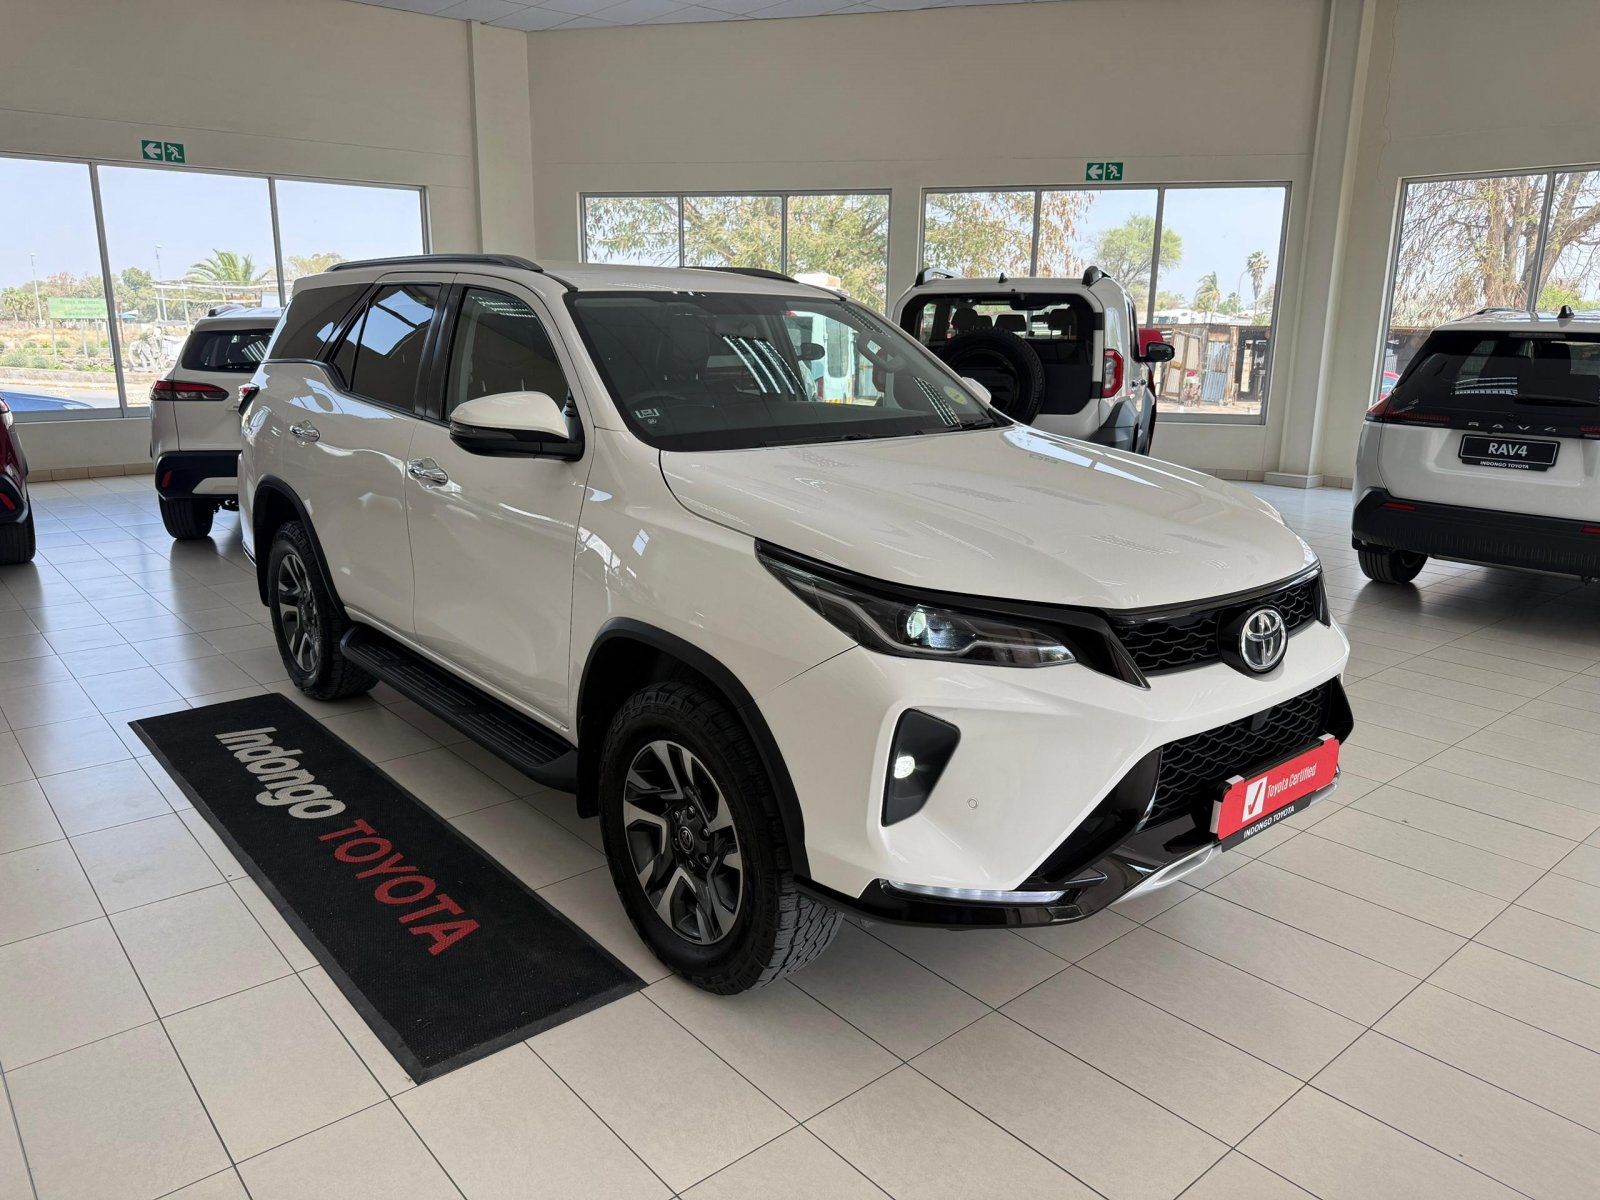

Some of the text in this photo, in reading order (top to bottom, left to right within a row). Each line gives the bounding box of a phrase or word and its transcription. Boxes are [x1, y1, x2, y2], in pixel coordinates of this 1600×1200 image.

[1480, 460, 1506, 468] INDONGO
[1488, 442, 1527, 457] RAV4
[1267, 763, 1317, 798] Toyota Certified
[1244, 805, 1295, 839] INDONGO TOYOTA
[215, 727, 480, 956] Indongo TOYOTA
